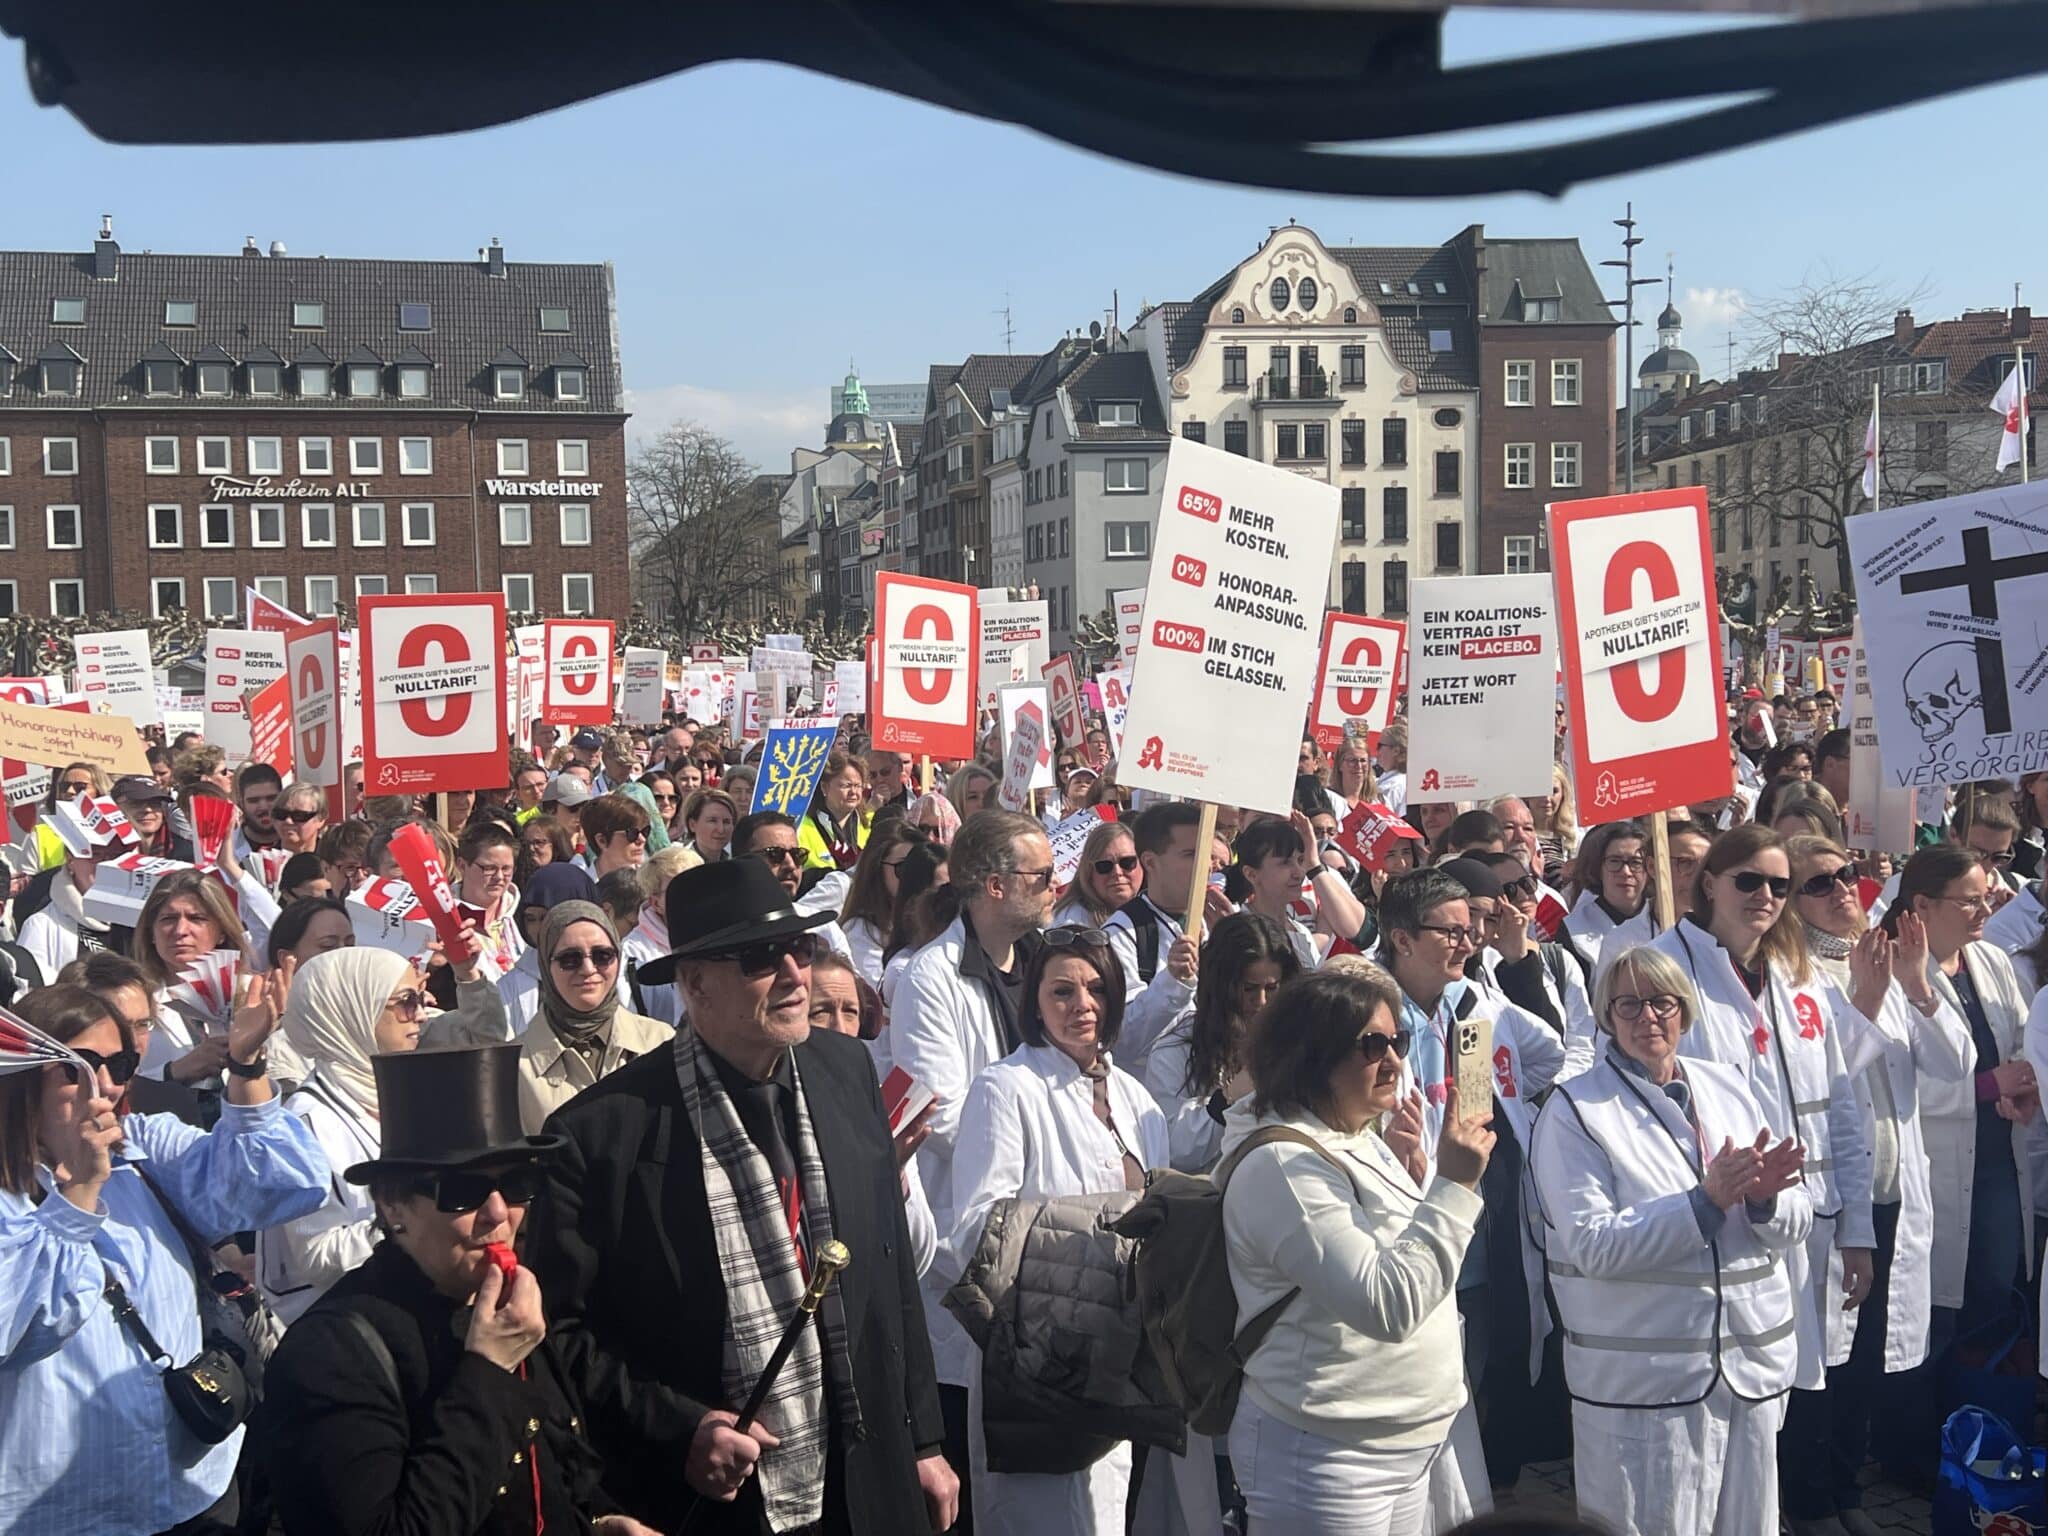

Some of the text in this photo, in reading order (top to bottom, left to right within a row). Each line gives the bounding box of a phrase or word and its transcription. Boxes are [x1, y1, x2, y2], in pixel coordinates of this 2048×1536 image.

[210, 475, 369, 500] Frankenheim ALT
[484, 479, 603, 496] Warsteiner
[1182, 493, 1274, 532] 65% MEHR
[1922, 516, 1937, 530] DAS
[1974, 511, 2048, 536] HONORARERHÖHU
[1226, 528, 1289, 559] KOSTEN.
[1176, 561, 1297, 605] 0% HONORAR-
[1214, 594, 1307, 630] ANPASSUNG.
[1424, 606, 1547, 623] EIN KOALITIONS-
[1585, 620, 1633, 640] APOTHEKEN
[1660, 606, 1682, 620] NICHT
[1684, 601, 1700, 613] ZUM
[1423, 624, 1522, 640] VERTRAG IST
[1603, 619, 1690, 657] NULLTARIF!
[1158, 625, 1275, 666] 100% IM STICH
[1423, 640, 1537, 657] KEIN PLACEBO.
[245, 651, 273, 659] MEHR
[899, 652, 957, 664] NULLTARIF!
[245, 660, 285, 669] KOSTEN.
[379, 670, 424, 682] APOTHEKEN
[450, 667, 472, 675] NICHT
[473, 664, 490, 672] ZUM
[560, 664, 601, 672] NULLTARIF!
[244, 678, 275, 686] HONO
[1205, 659, 1286, 691] GELASSEN.
[1336, 675, 1383, 684] NULLTARIF!
[1422, 674, 1517, 690] JETZT WORT
[395, 675, 478, 694] NULLTARIF!
[1422, 692, 1484, 706] HALTEN!
[783, 719, 818, 729] HAGEN
[1919, 729, 2048, 764] SO STIRB
[390, 892, 418, 928] NULLT
